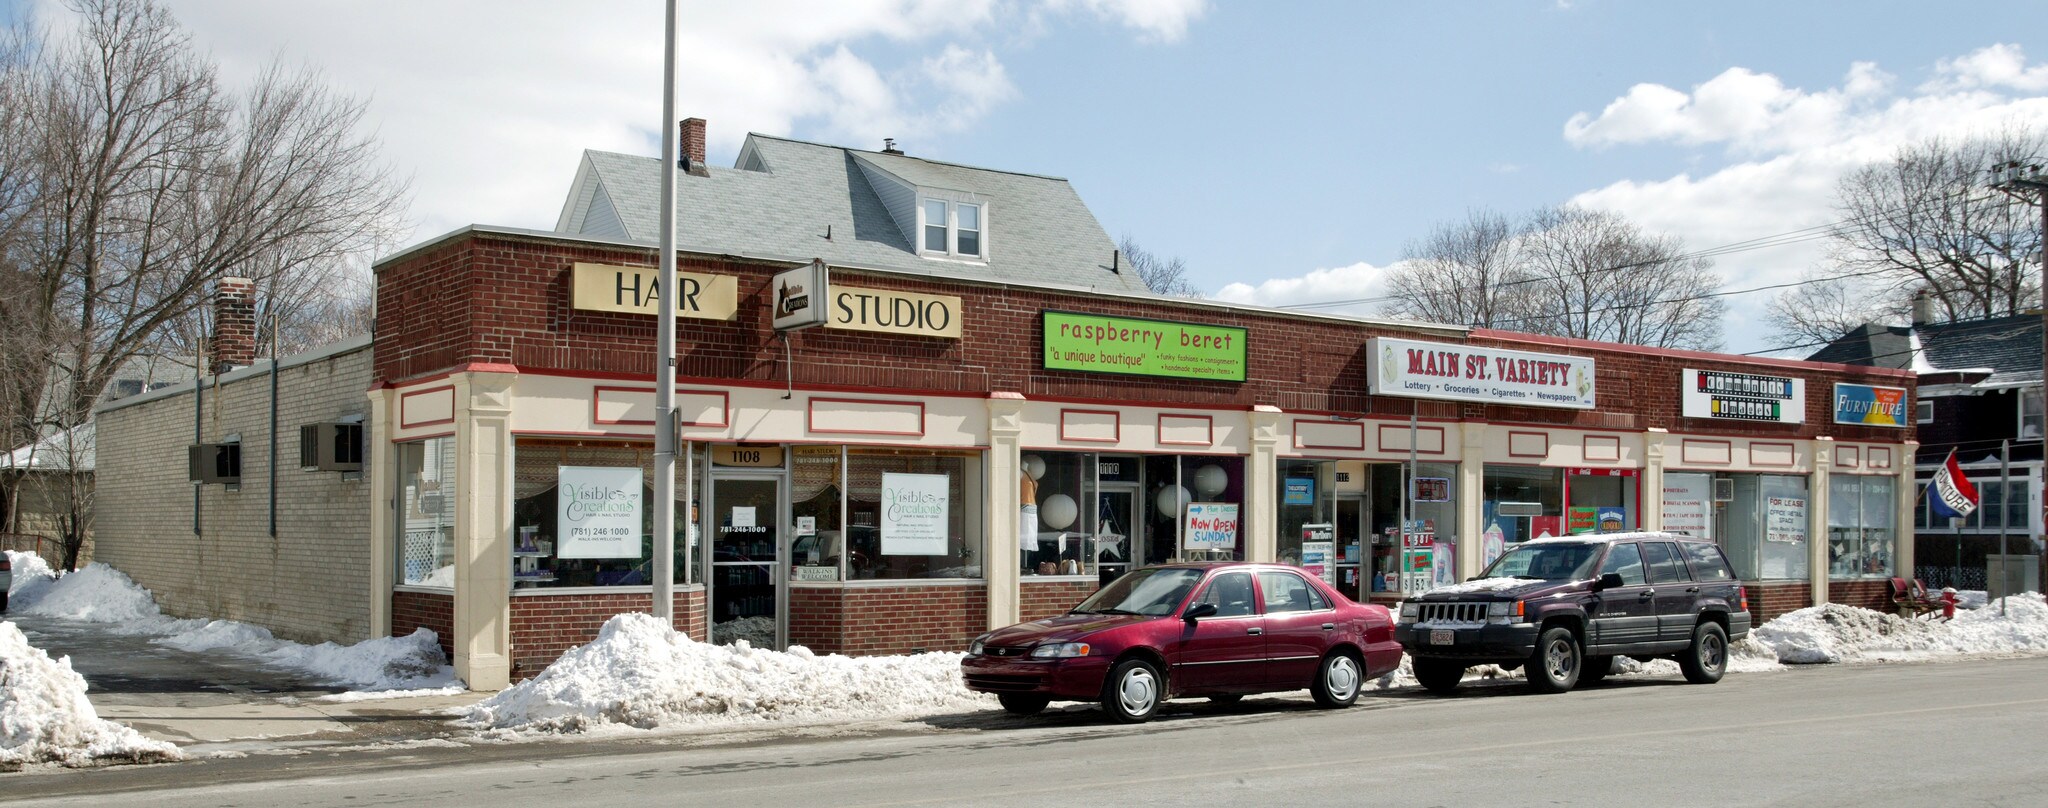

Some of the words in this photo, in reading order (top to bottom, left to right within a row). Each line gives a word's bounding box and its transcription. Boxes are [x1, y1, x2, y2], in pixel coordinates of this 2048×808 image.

[616, 272, 700, 311] HAR
[837, 292, 950, 331] STUDIO
[1060, 321, 1164, 350] raspberry
[1180, 327, 1232, 350] beret
[1064, 349, 1096, 366] unique
[1100, 350, 1146, 369] boutique"
[1160, 353, 1175, 363] funky
[1177, 354, 1199, 363] fashions
[1204, 357, 1236, 367] consignment
[1406, 348, 1460, 377] MAIN
[1465, 354, 1492, 381] ST.
[1495, 357, 1572, 387] VARIETY
[1164, 364, 1191, 373] handmade
[1192, 365, 1216, 375] specialty
[1217, 366, 1231, 375] items
[1404, 380, 1432, 393] Lottery
[1444, 383, 1480, 395] Groceries
[1491, 387, 1526, 399] Cigarettes
[1537, 391, 1578, 402] Newspapers
[1706, 374, 1785, 396] Community
[1720, 400, 1773, 417] Images
[1837, 394, 1903, 417] FURNITURE
[733, 450, 760, 463] 1108
[1100, 462, 1119, 475] 1110
[562, 482, 617, 502] Visible
[884, 487, 929, 504] Visible
[1769, 498, 1782, 506] FOR
[1784, 499, 1804, 508] LEASE
[571, 527, 591, 536] (781)
[593, 527, 608, 536] 246
[611, 527, 629, 536] 1000
[1190, 517, 1211, 530] NOW
[1213, 517, 1236, 532] OPEN
[1194, 531, 1233, 543] SUNDAY
[1311, 530, 1333, 540] Marlboro
